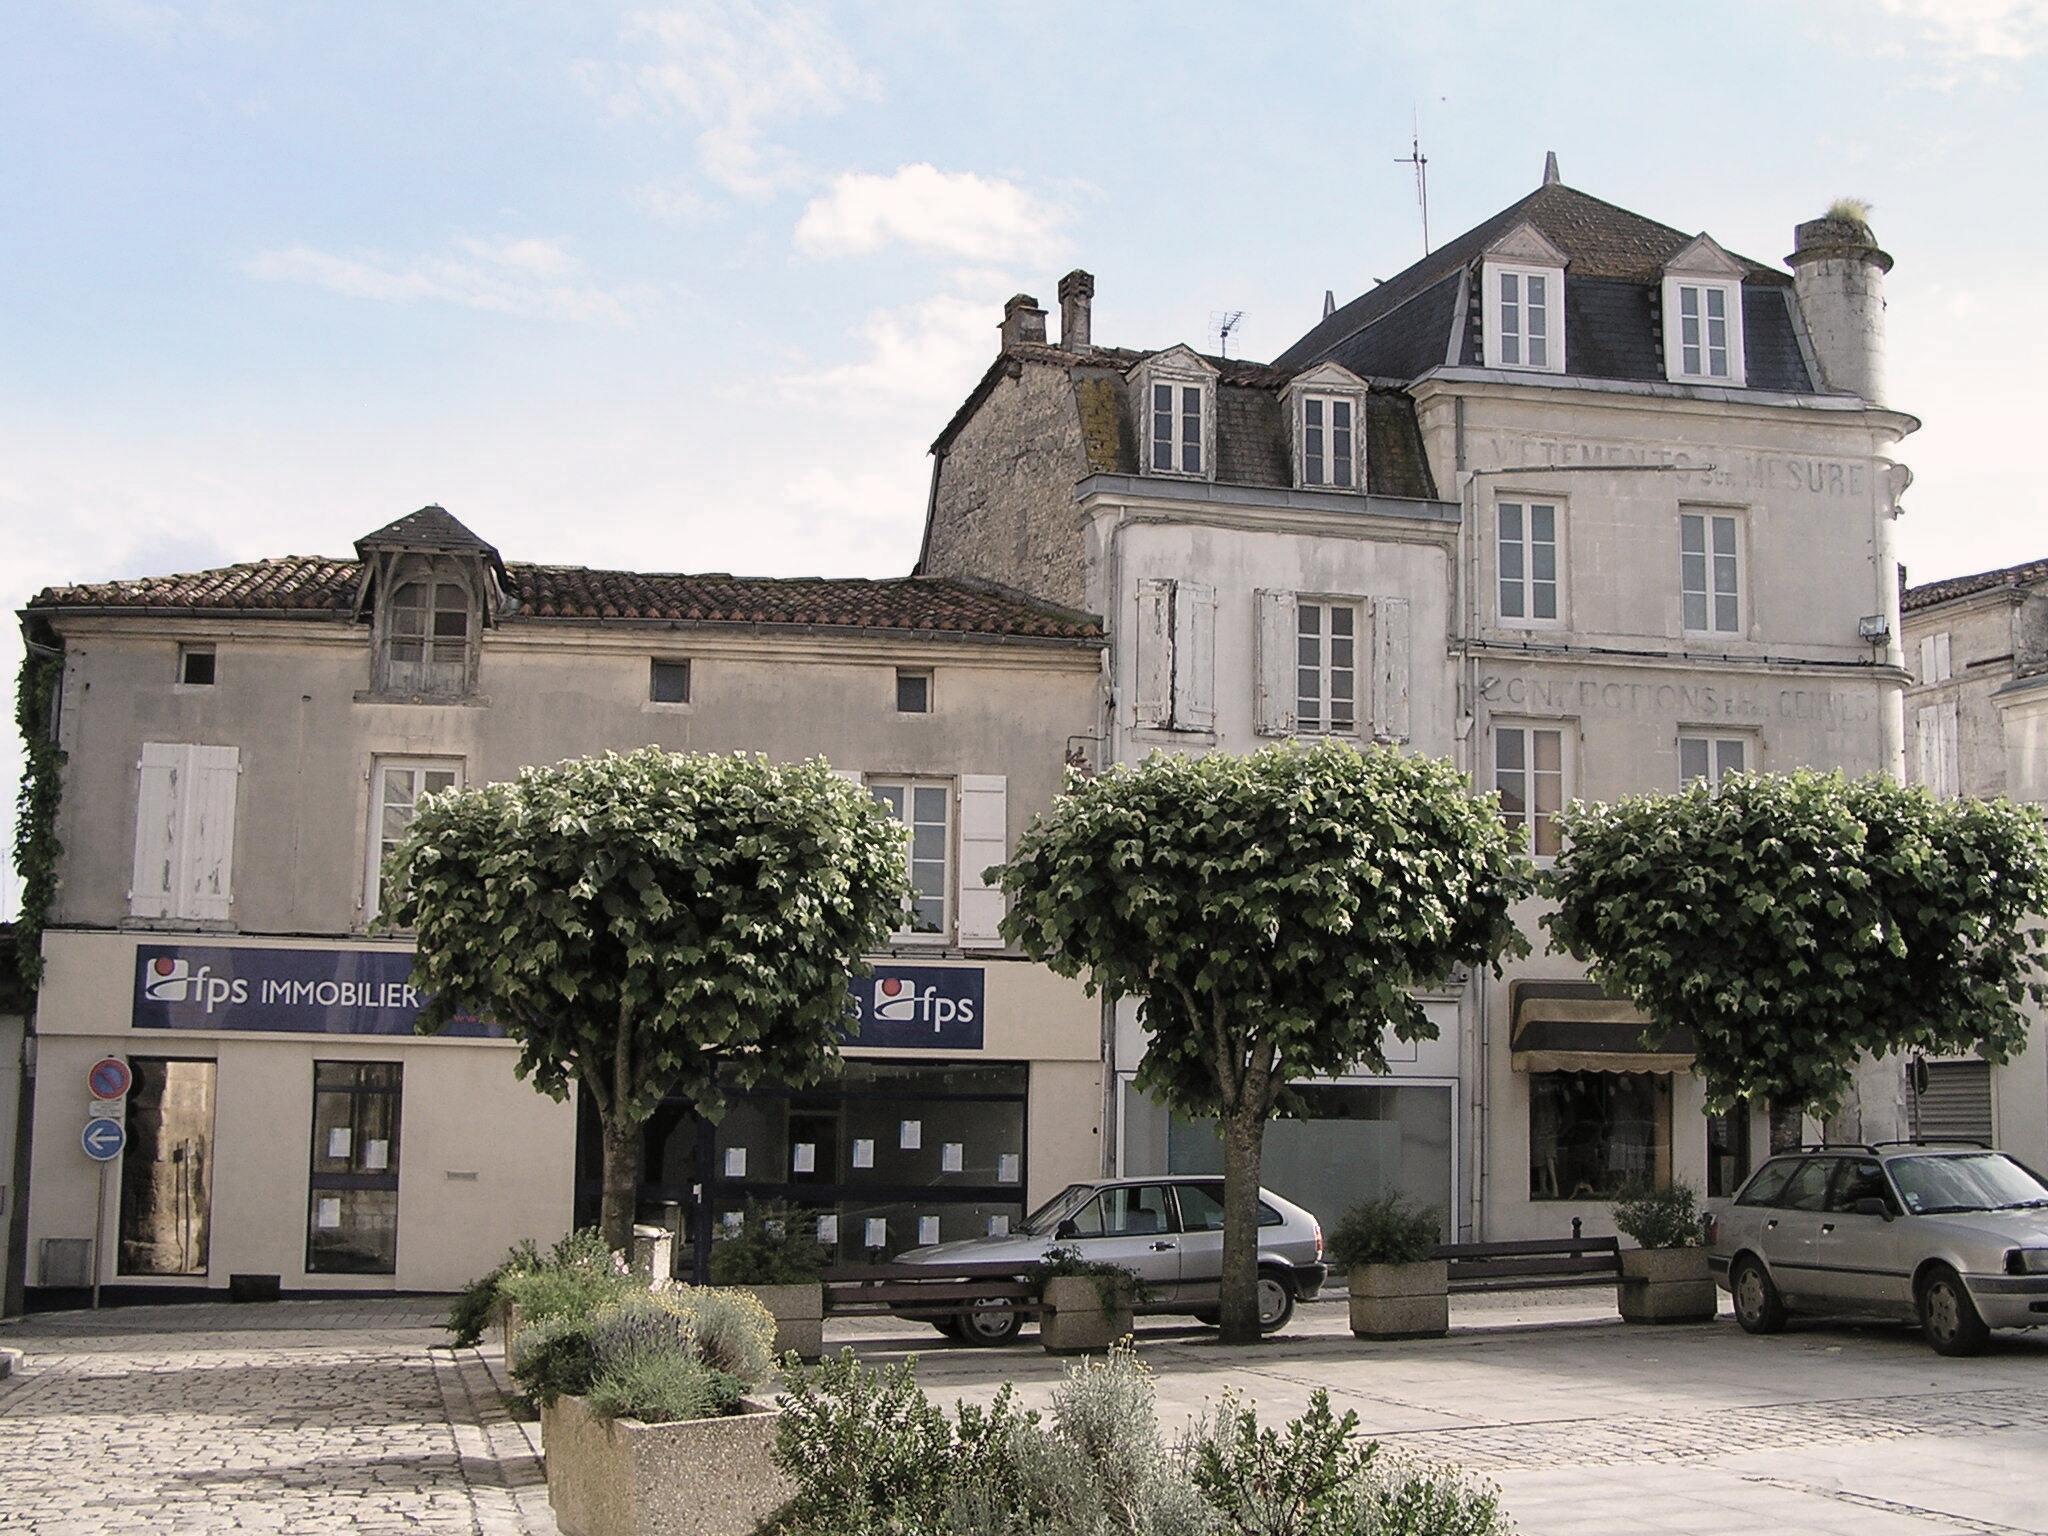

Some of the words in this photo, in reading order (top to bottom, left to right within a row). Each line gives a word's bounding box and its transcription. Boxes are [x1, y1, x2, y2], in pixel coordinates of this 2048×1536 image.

[1746, 455, 1864, 497] MESURE
[1480, 676, 1718, 717] CONFECTIONS
[192, 965, 249, 1013] fps
[262, 979, 420, 1008] IMMOBILIER
[918, 986, 974, 1032] fps
